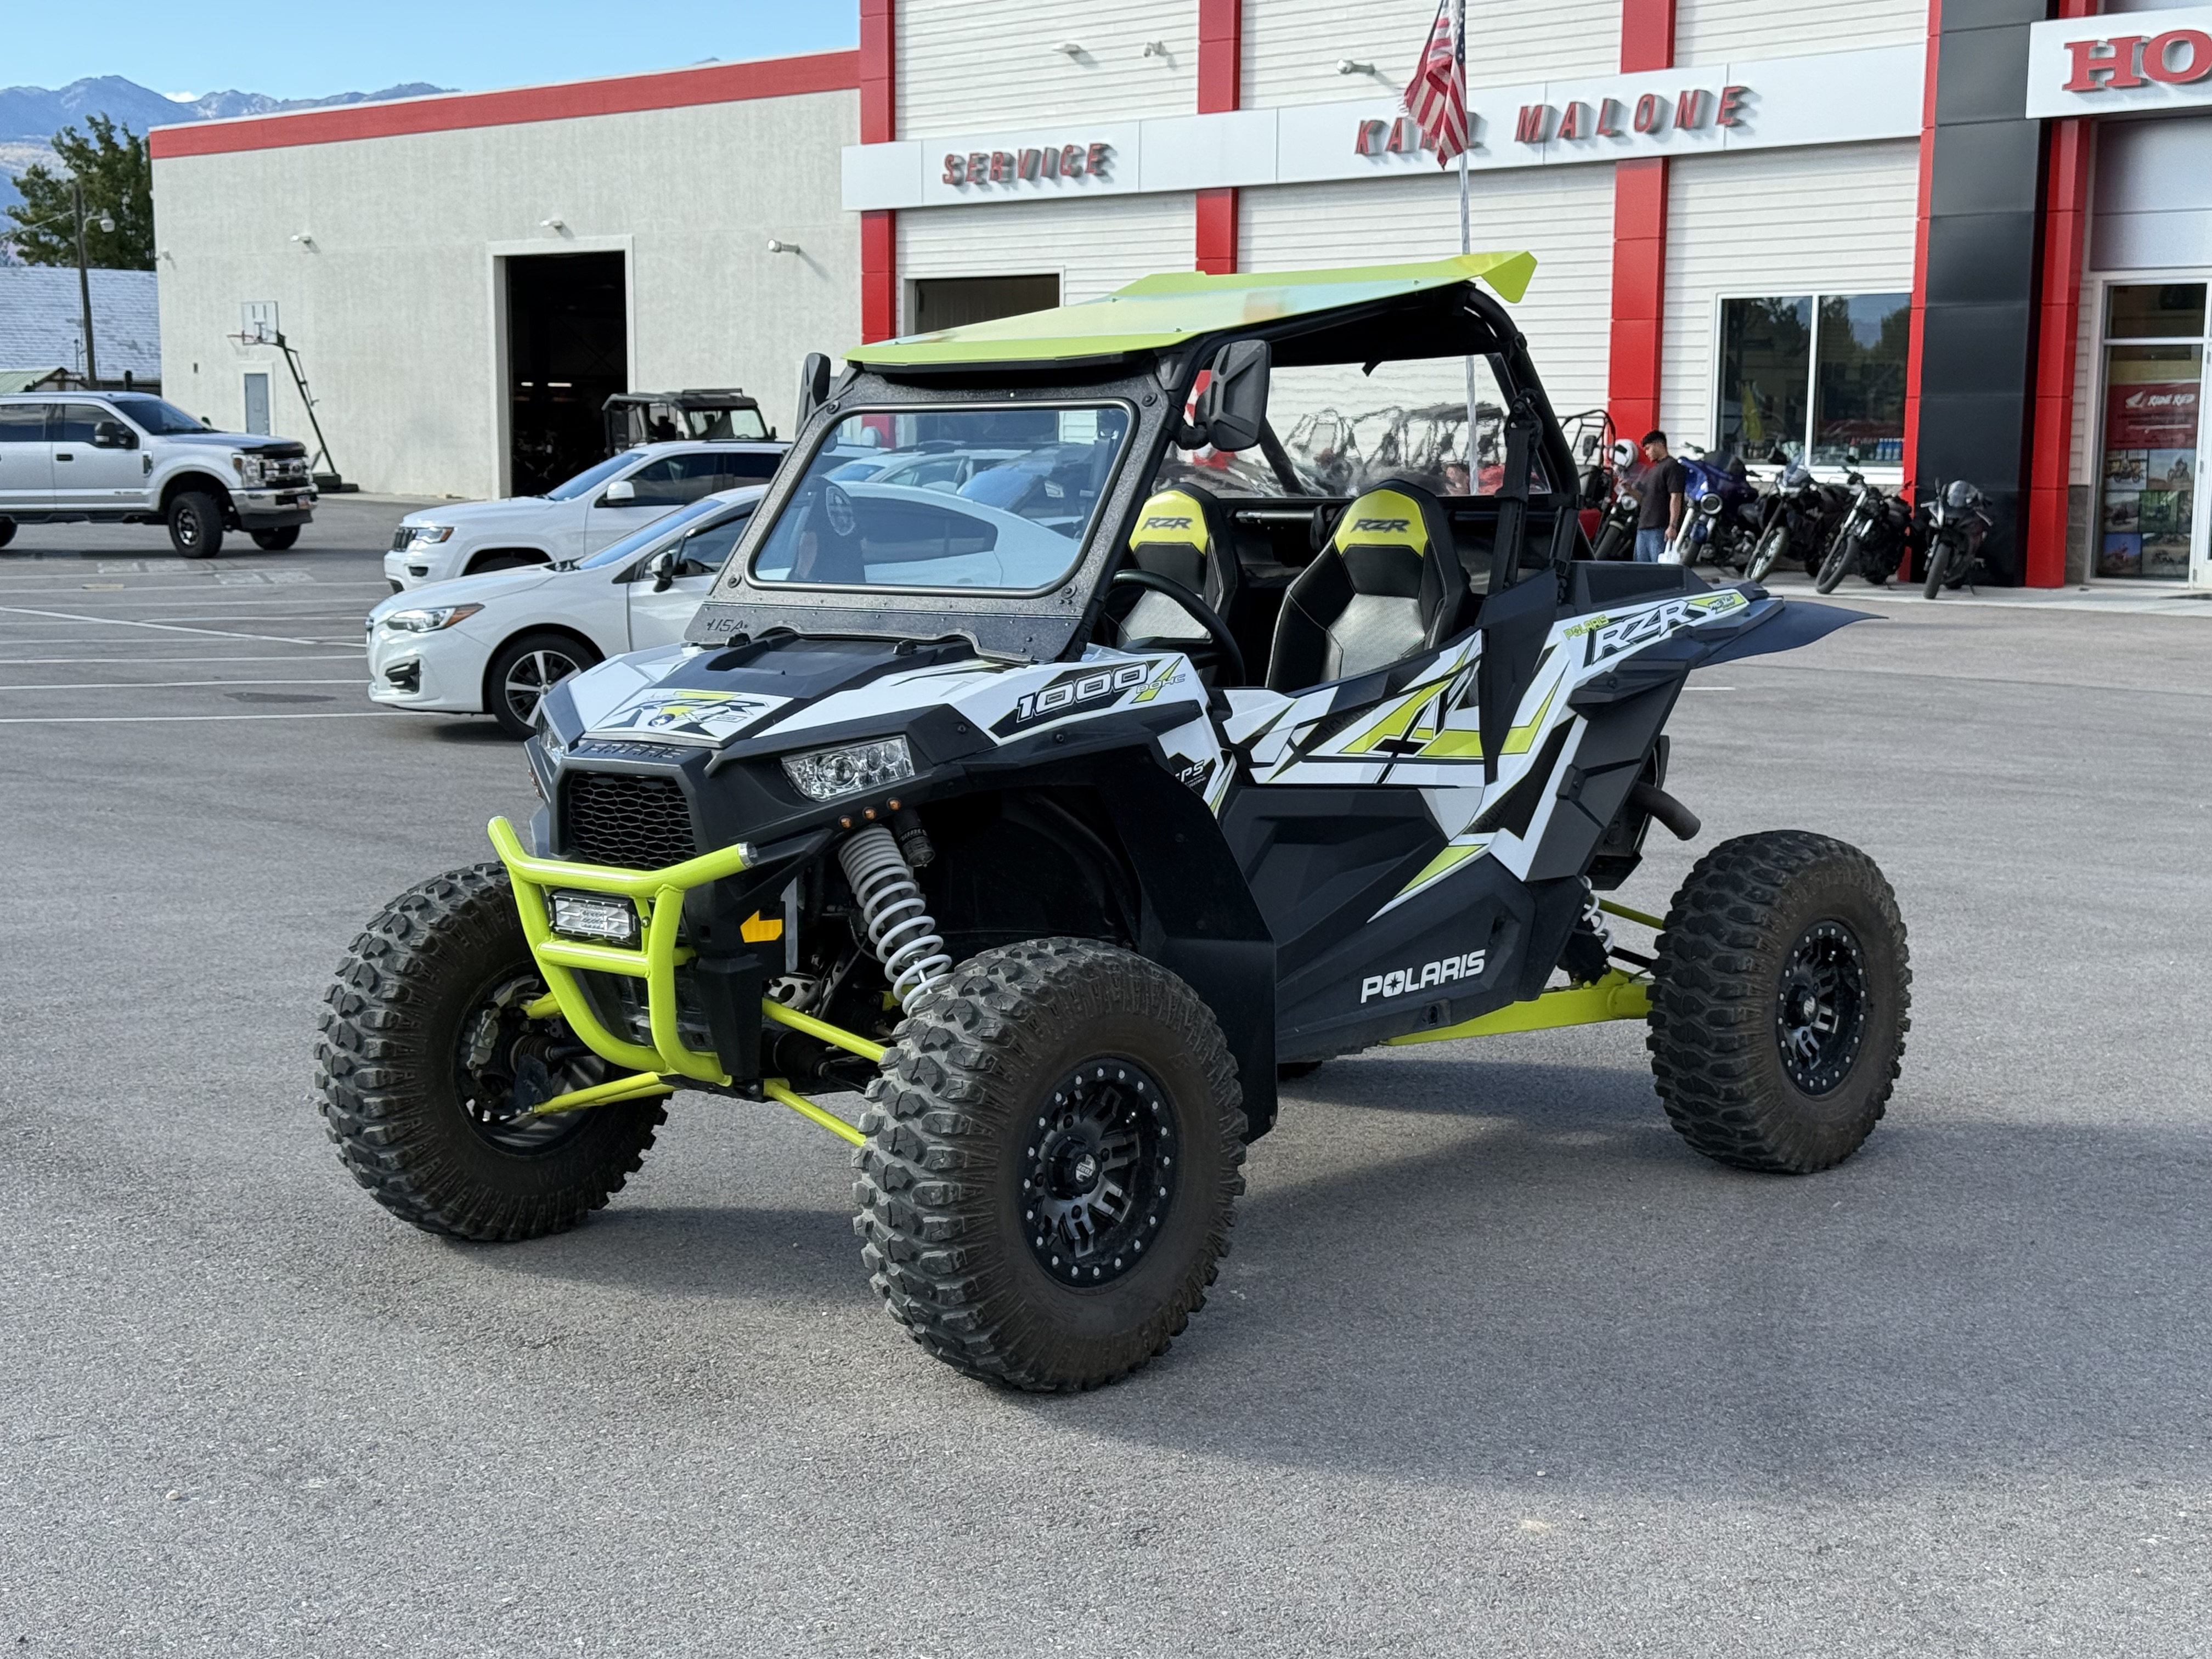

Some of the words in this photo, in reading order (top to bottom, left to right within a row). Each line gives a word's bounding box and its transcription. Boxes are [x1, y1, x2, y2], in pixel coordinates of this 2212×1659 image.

[2062, 29, 2212, 91] HO
[1355, 112, 1487, 155] KA
[1515, 86, 1750, 144] MALONE
[943, 143, 1116, 185] SERVICE
[2147, 394, 2173, 407] RIDE
[2172, 393, 2195, 407] RED
[1141, 516, 1193, 531] RZR
[1350, 518, 1412, 533] RZR
[707, 618, 743, 633] USA
[1563, 614, 1610, 641] POLARIS
[1592, 599, 1695, 665] RZR
[1017, 662, 1149, 723] 1000
[1136, 673, 1186, 694] DOHC
[1360, 949, 1486, 1003] POLARIS
